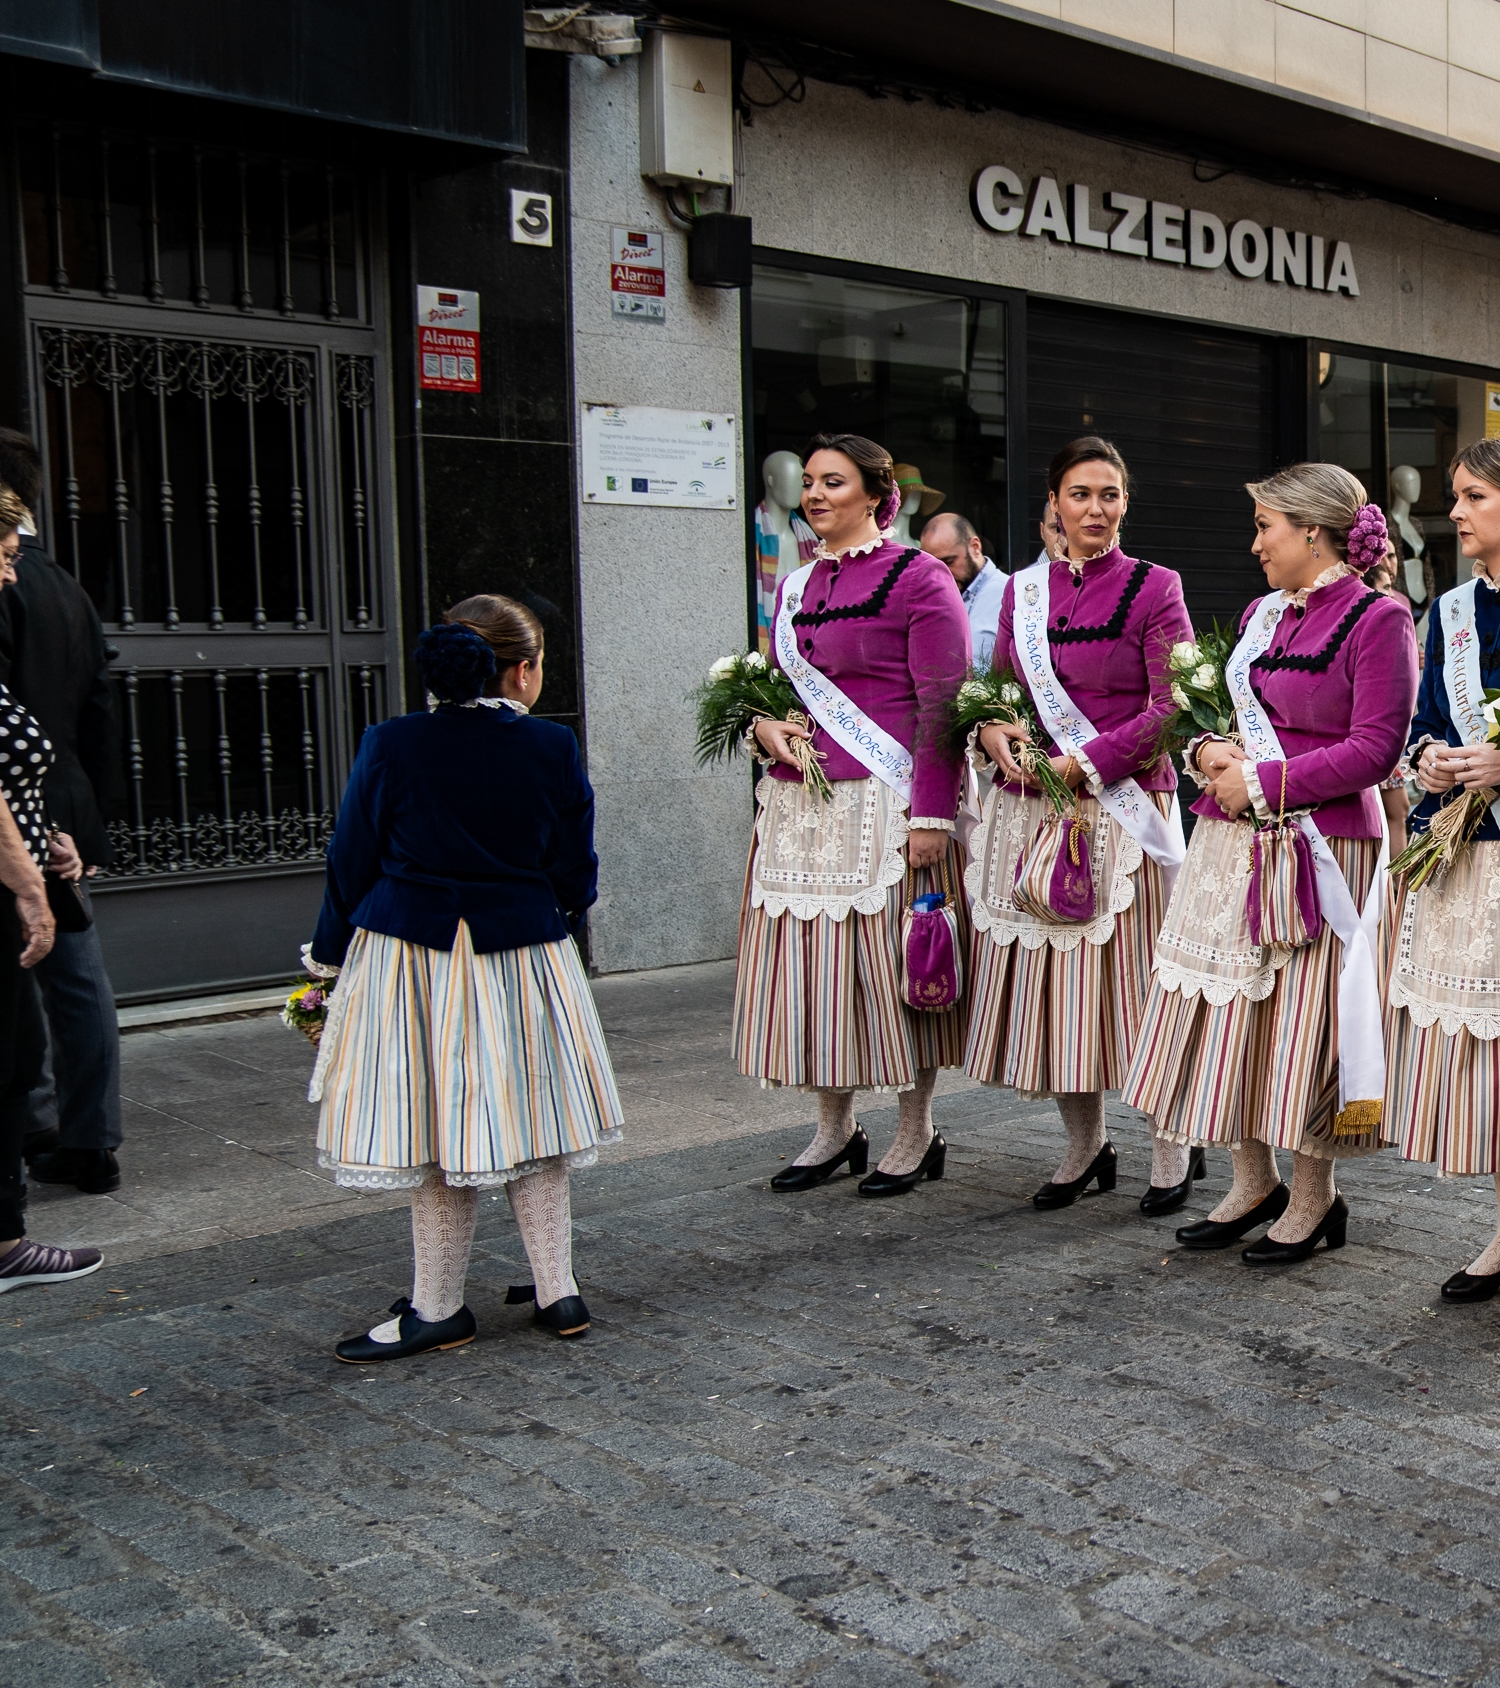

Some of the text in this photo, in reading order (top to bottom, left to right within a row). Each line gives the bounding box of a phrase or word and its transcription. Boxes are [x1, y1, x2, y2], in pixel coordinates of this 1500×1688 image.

[518, 198, 550, 236] 5
[970, 165, 1360, 297] CALZEDONIA
[614, 266, 663, 285] Alarma
[422, 329, 475, 348] Alarma
[779, 621, 796, 667] DAMA
[804, 678, 826, 702] DE
[1025, 622, 1042, 673] DAMA
[1043, 689, 1063, 716] DE
[1234, 646, 1263, 738] DAMA DE
